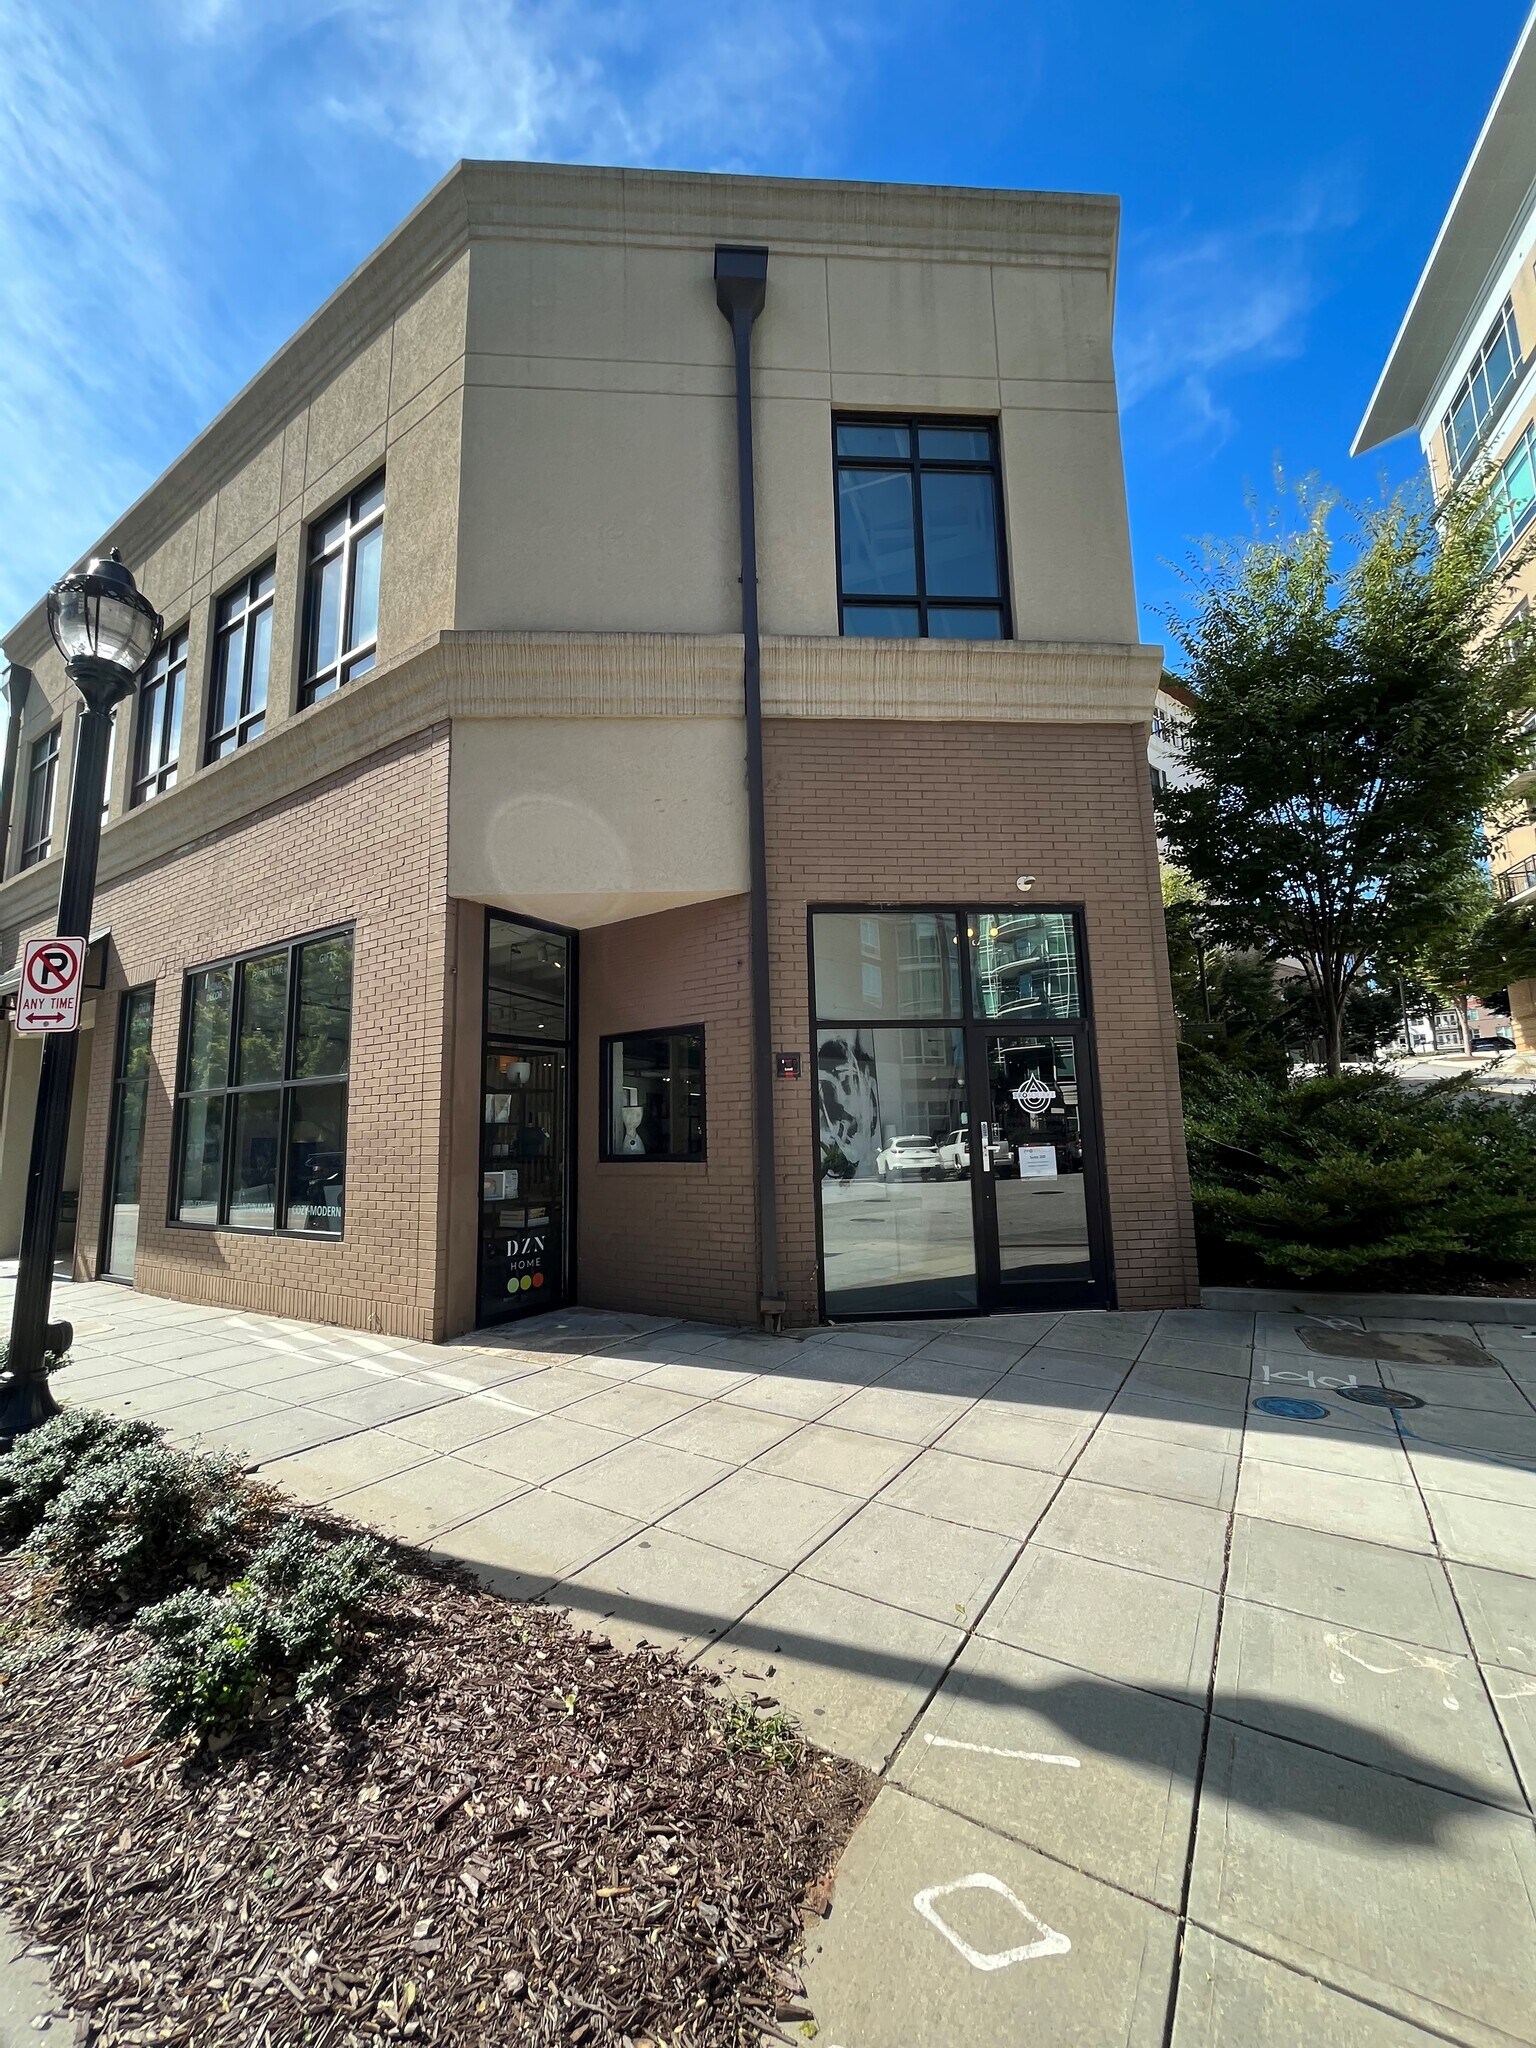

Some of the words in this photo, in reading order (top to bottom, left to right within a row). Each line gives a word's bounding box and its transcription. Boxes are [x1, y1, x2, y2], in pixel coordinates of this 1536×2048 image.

[23, 998, 45, 1010] ANY
[51, 997, 75, 1009] TIME
[292, 1204, 342, 1217] COZY-MODERN
[507, 1236, 546, 1257] DZN
[511, 1257, 541, 1271] HOME
